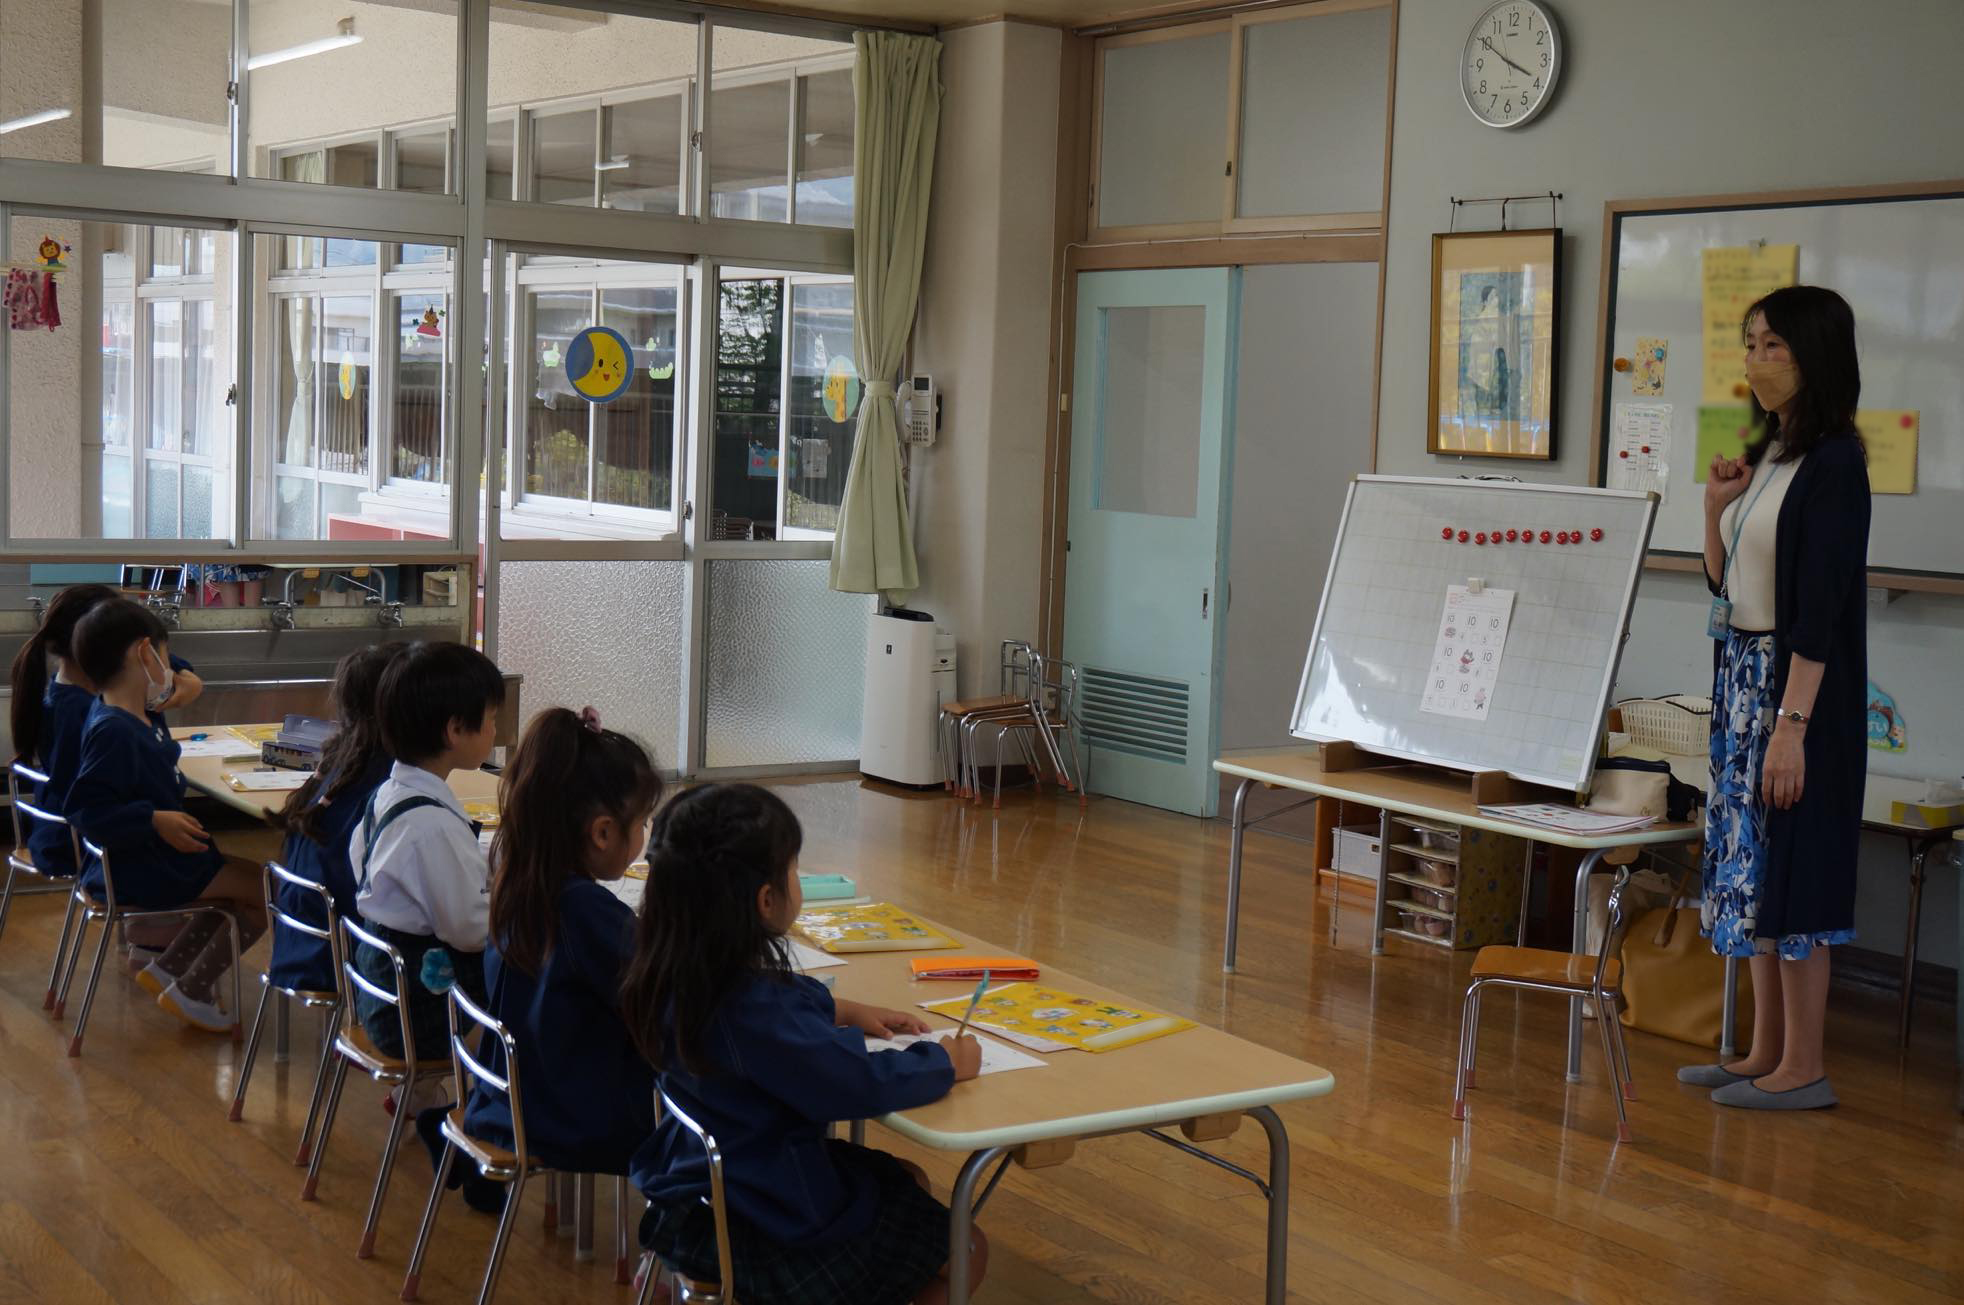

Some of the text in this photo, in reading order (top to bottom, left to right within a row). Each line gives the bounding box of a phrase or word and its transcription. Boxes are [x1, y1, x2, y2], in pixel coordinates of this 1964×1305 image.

[1509, 12, 1520, 26] 12
[1528, 16, 1532, 30] 1
[1493, 20, 1502, 35] 11
[1481, 36, 1493, 51] 10
[1536, 30, 1544, 45] 2
[1476, 58, 1484, 72] 9
[1540, 53, 1548, 68] 3
[1480, 80, 1487, 94] 8
[1533, 77, 1541, 90] 4
[1491, 94, 1498, 108] 7
[1520, 91, 1528, 105] 5
[1504, 99, 1511, 114] 6
[1467, 616, 1477, 626] 10
[1490, 618, 1499, 629] 10
[1443, 647, 1493, 662] 10 10
[1435, 679, 1469, 693] 10 10
